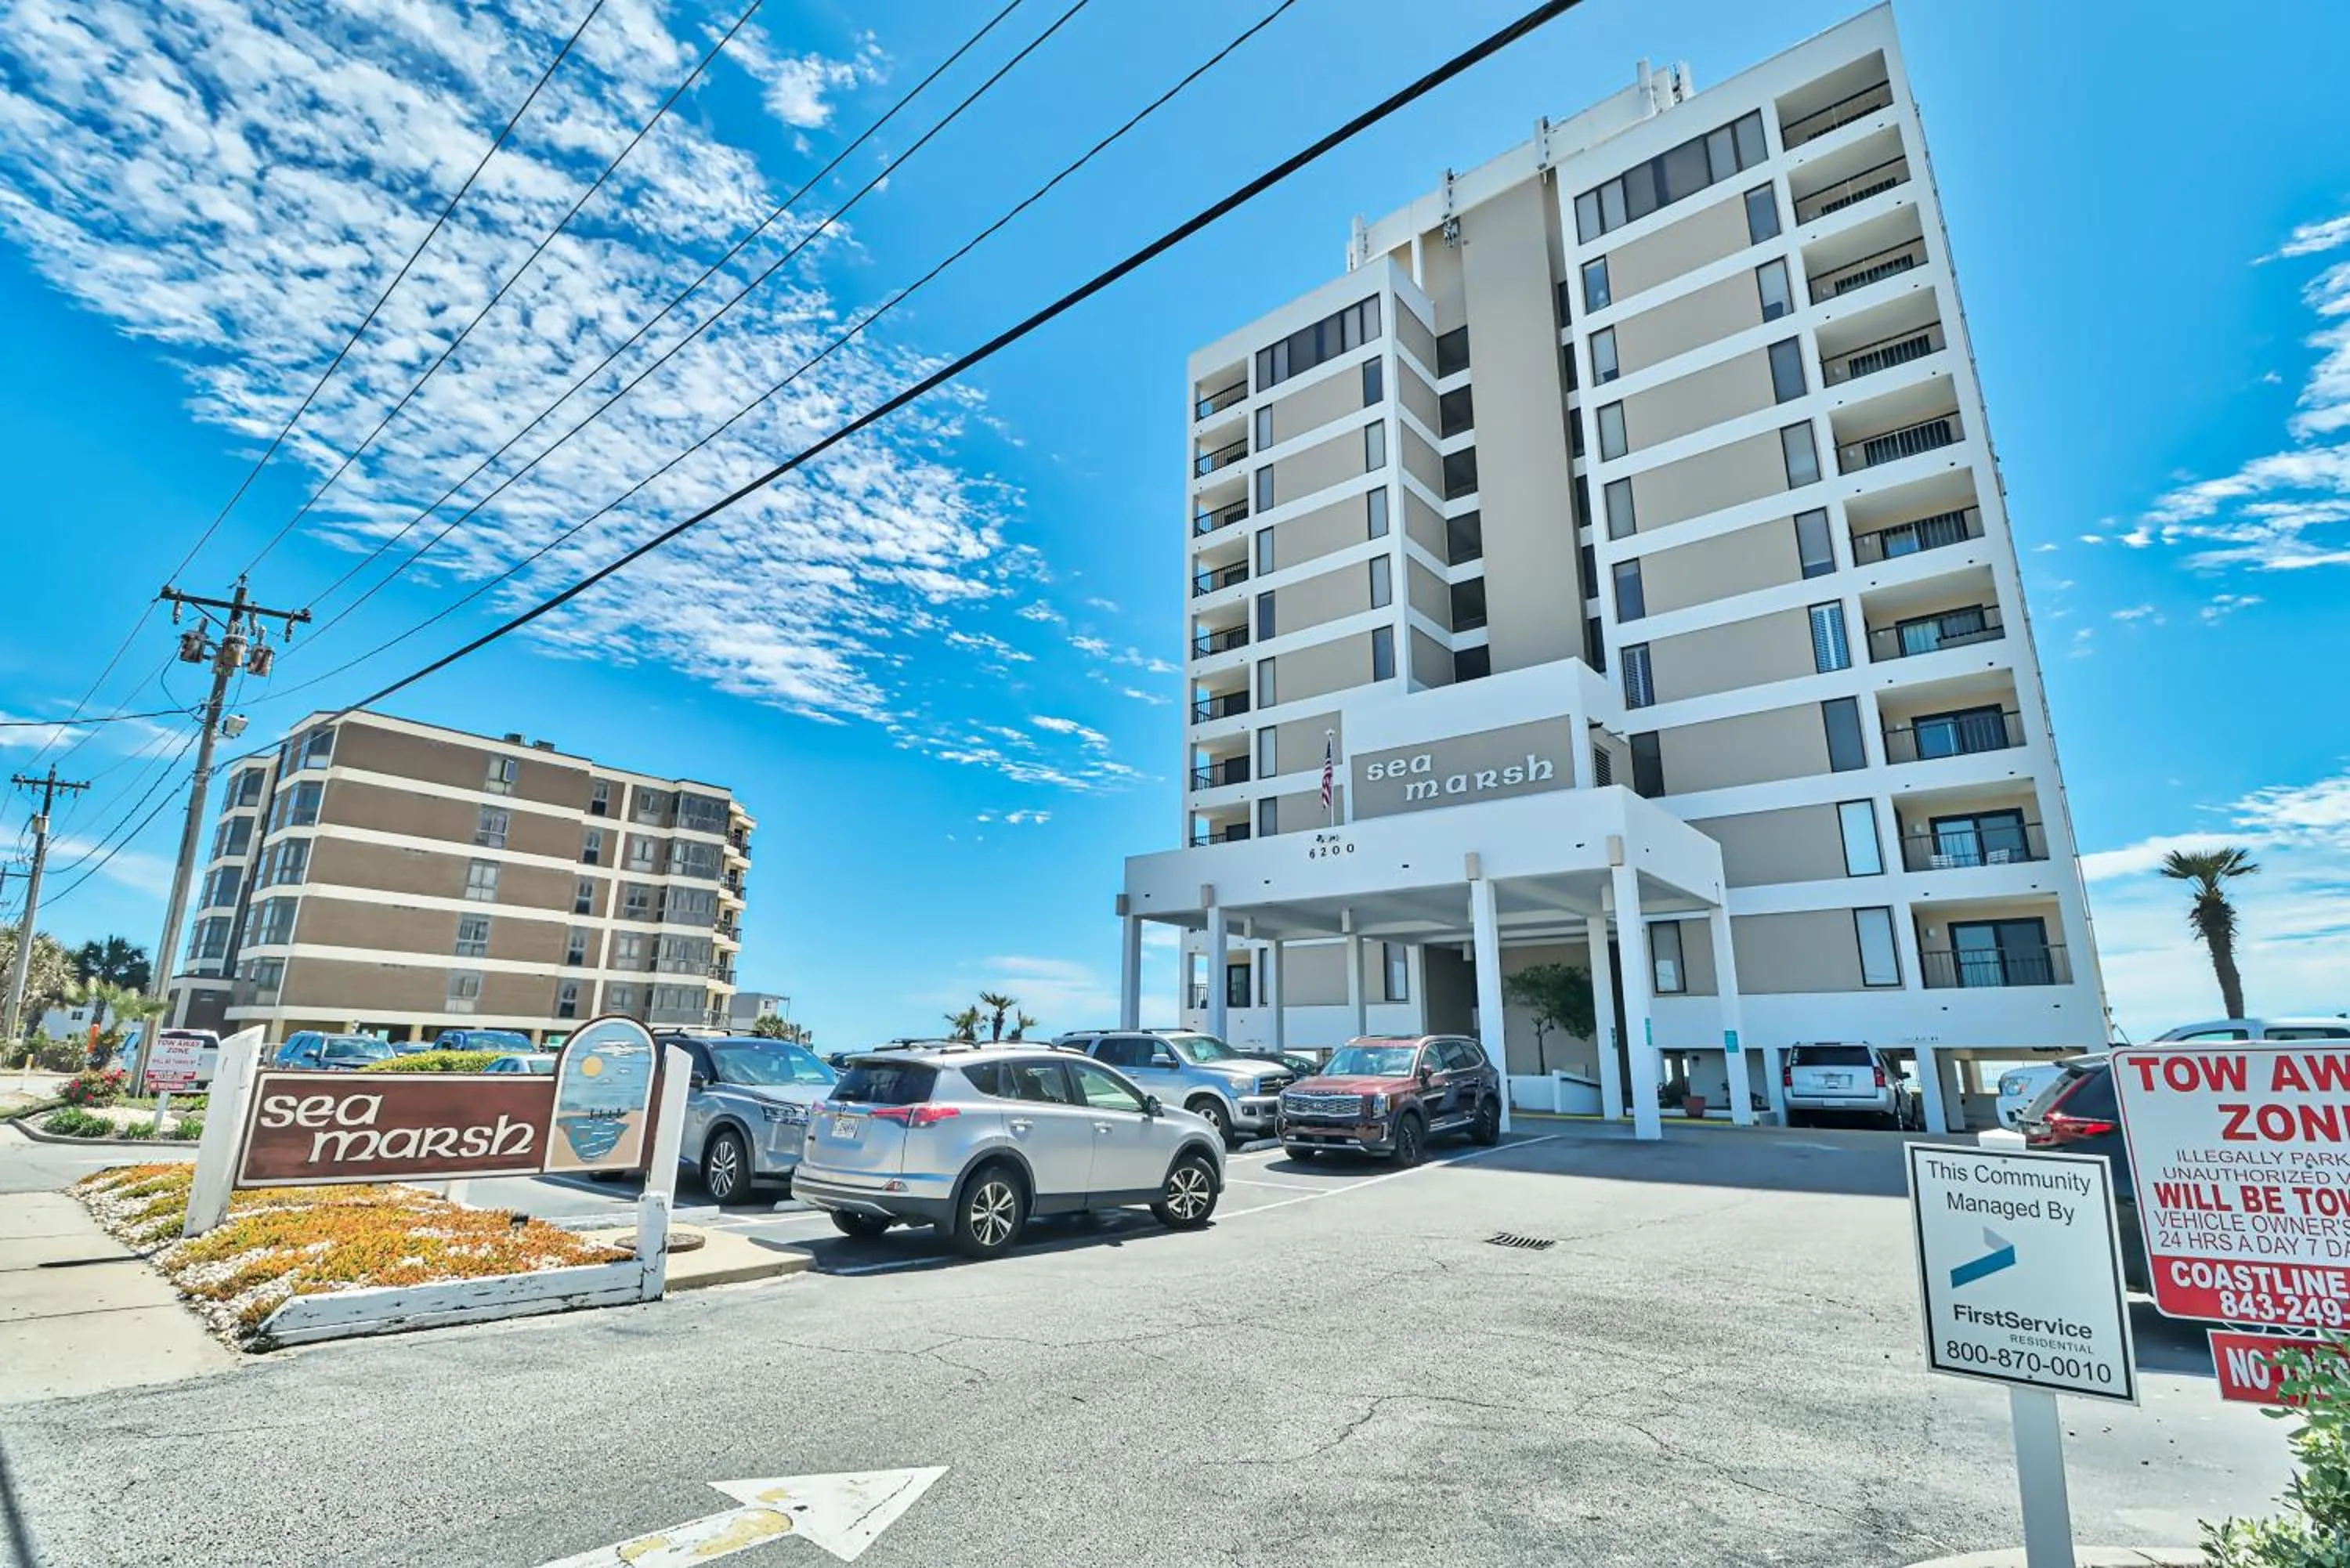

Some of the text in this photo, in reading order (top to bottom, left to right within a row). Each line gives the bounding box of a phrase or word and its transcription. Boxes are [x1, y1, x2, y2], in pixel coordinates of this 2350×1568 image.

[1309, 843, 1354, 859] 6200
[2128, 1056, 2247, 1092] TOW
[2218, 1104, 2350, 1143] ZON
[2176, 1149, 2283, 1165] ILLEGALLY
[1926, 1160, 2091, 1196] This Community
[2163, 1166, 2330, 1185] UNAUTHORIZED
[1947, 1191, 2075, 1226] Managed By
[2154, 1183, 2232, 1212] WILL
[2240, 1186, 2285, 1214] BE
[2154, 1210, 2247, 1232] VEHICLE
[2160, 1230, 2182, 1248] 24
[2189, 1232, 2232, 1251] HRS
[2238, 1235, 2254, 1252] A
[2258, 1235, 2299, 1255] DAY
[2306, 1238, 2316, 1256] 7
[2171, 1260, 2350, 1299] COASTLINE
[1953, 1303, 2093, 1339] FirstService
[2009, 1334, 2094, 1354] RESIDENTIAL
[1947, 1340, 2112, 1384] 800-870-0010
[2225, 1346, 2270, 1391] NO
